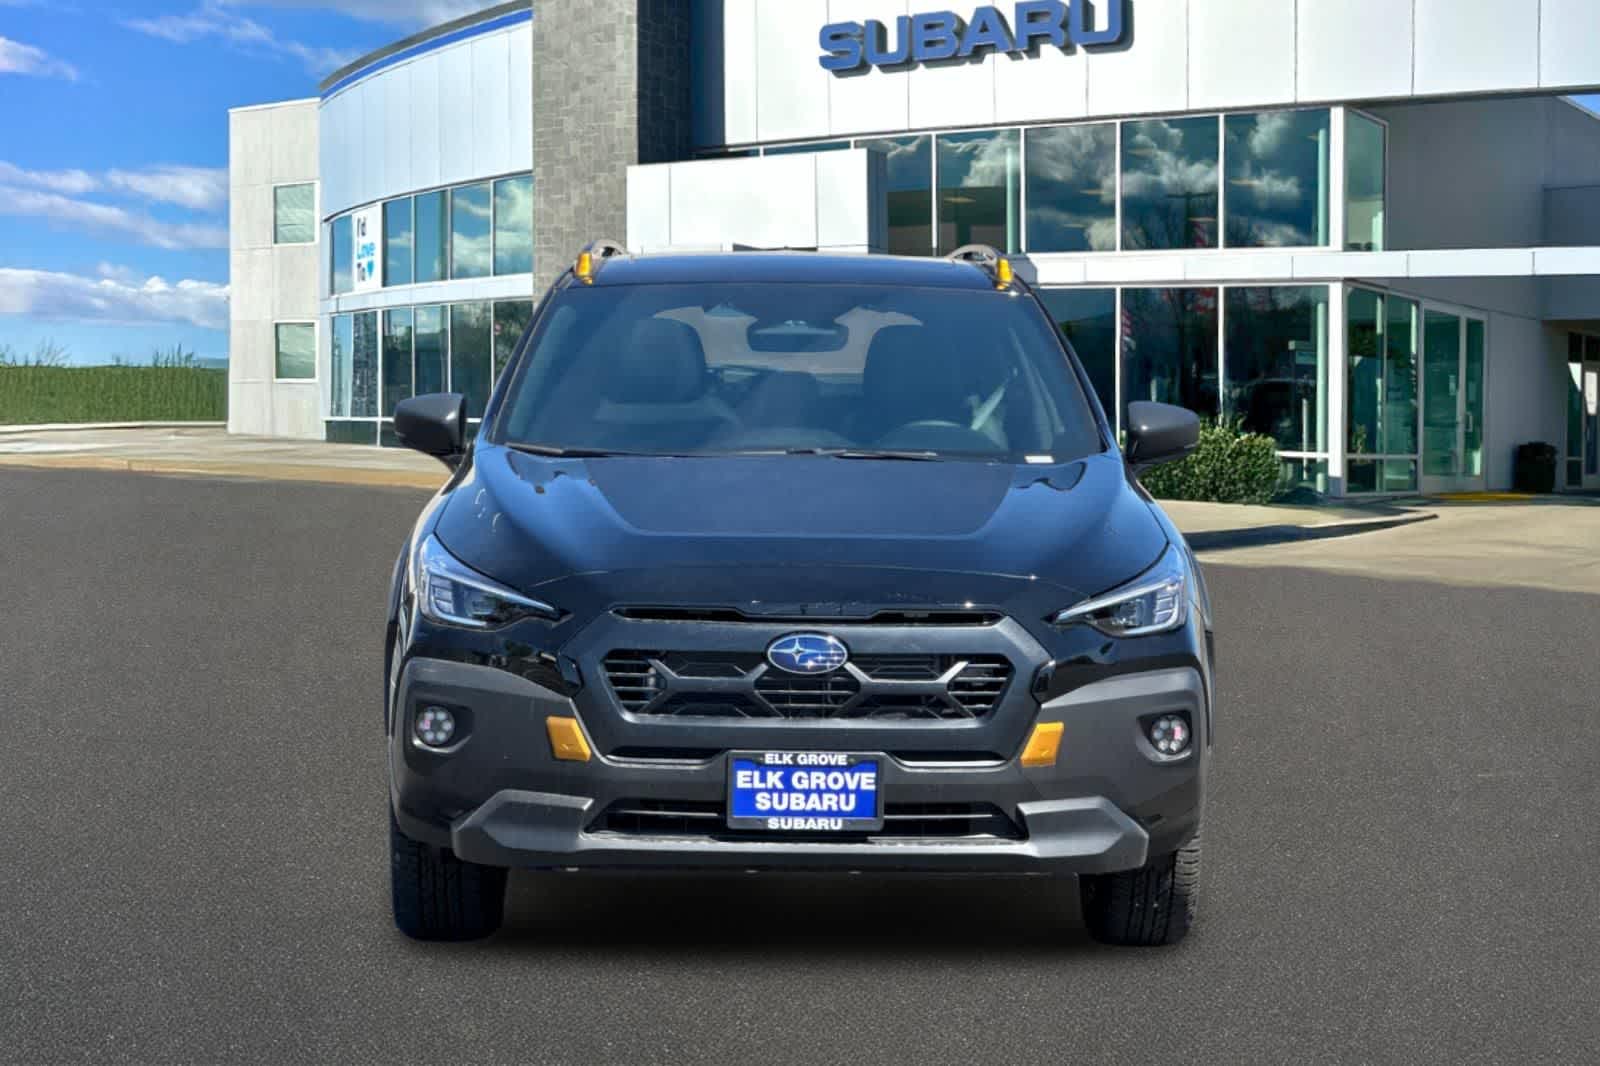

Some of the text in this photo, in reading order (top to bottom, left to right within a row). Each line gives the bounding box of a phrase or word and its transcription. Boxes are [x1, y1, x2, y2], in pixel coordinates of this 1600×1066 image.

[818, 0, 1134, 78] SUBARU
[764, 753, 847, 765] ELK GROVE
[736, 770, 876, 790] ELK GROVE
[755, 792, 856, 811] SUBARU
[767, 818, 843, 830] SUBARU
